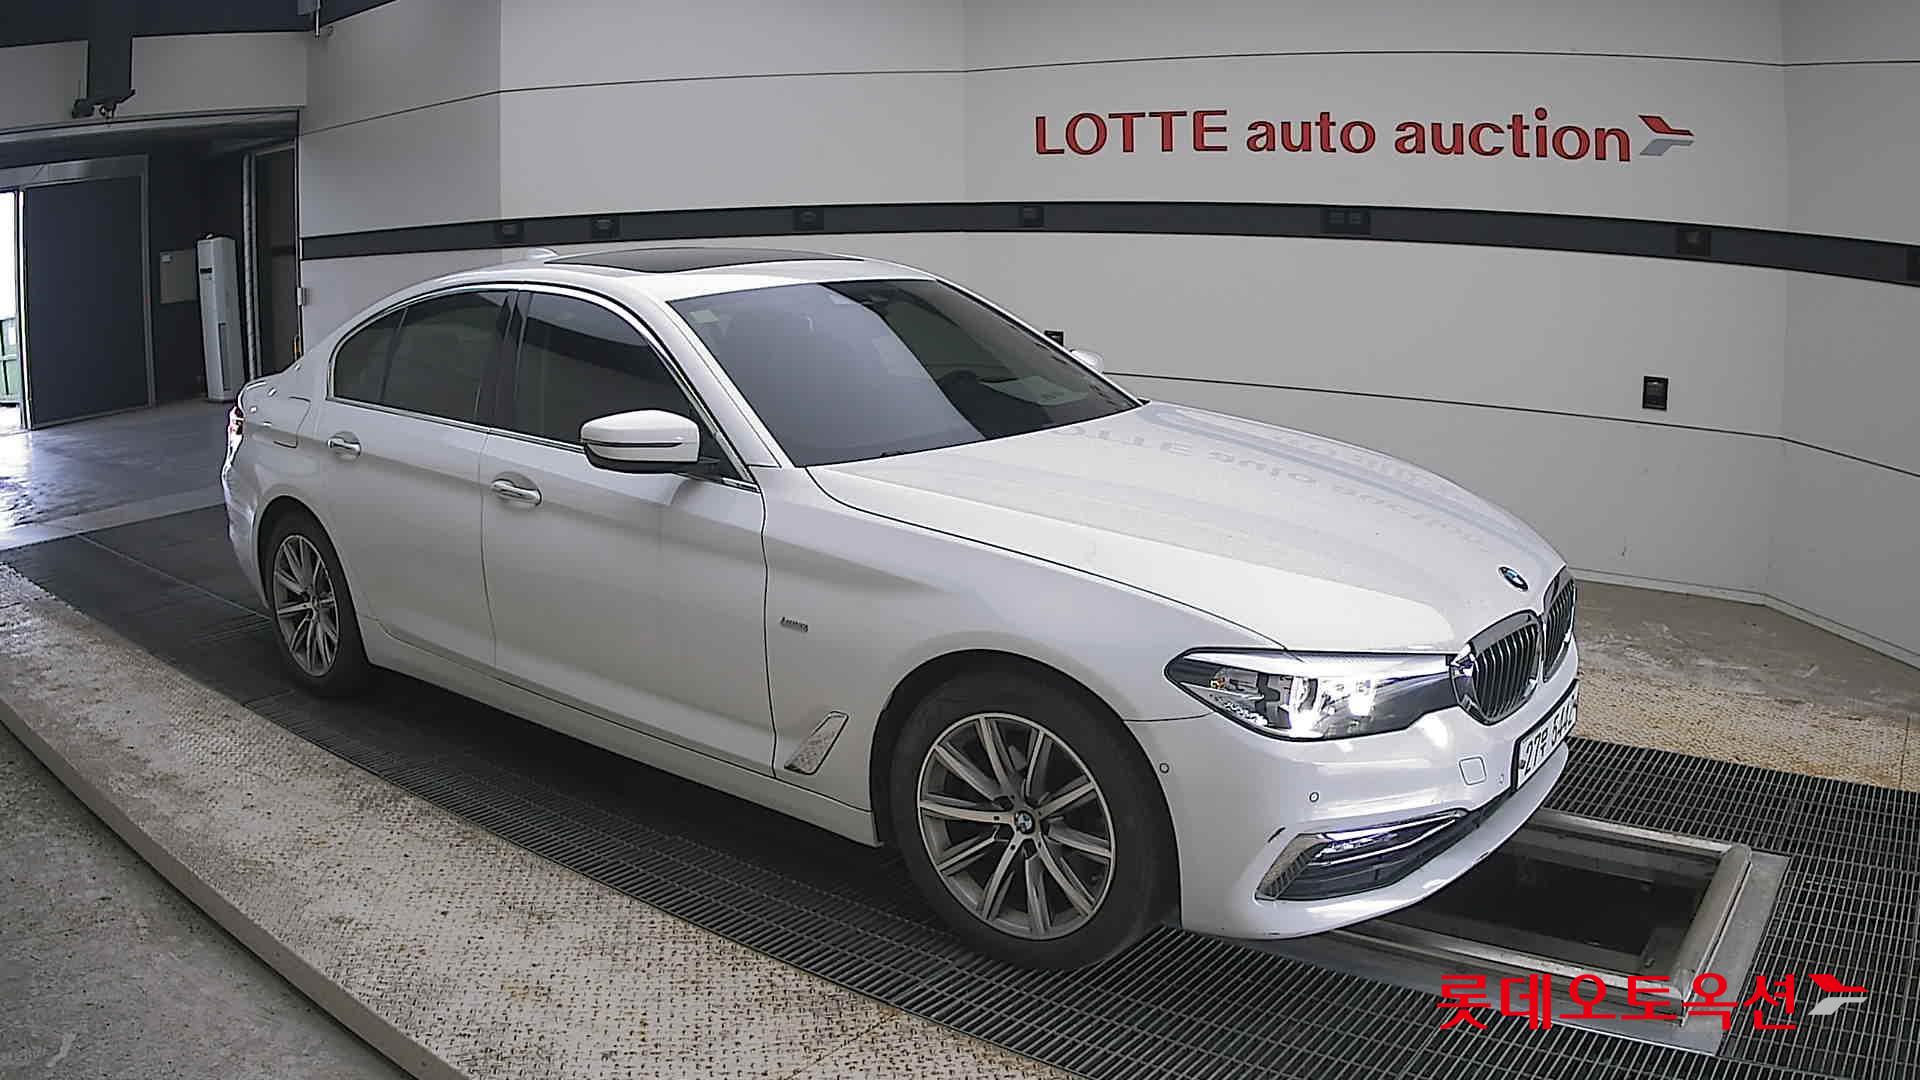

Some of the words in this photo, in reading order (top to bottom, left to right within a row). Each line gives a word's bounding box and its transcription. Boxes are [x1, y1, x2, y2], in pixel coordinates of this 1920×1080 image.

[1034, 109, 1228, 155] LOTTE
[1246, 111, 1377, 155] auto
[1394, 107, 1633, 163] auction
